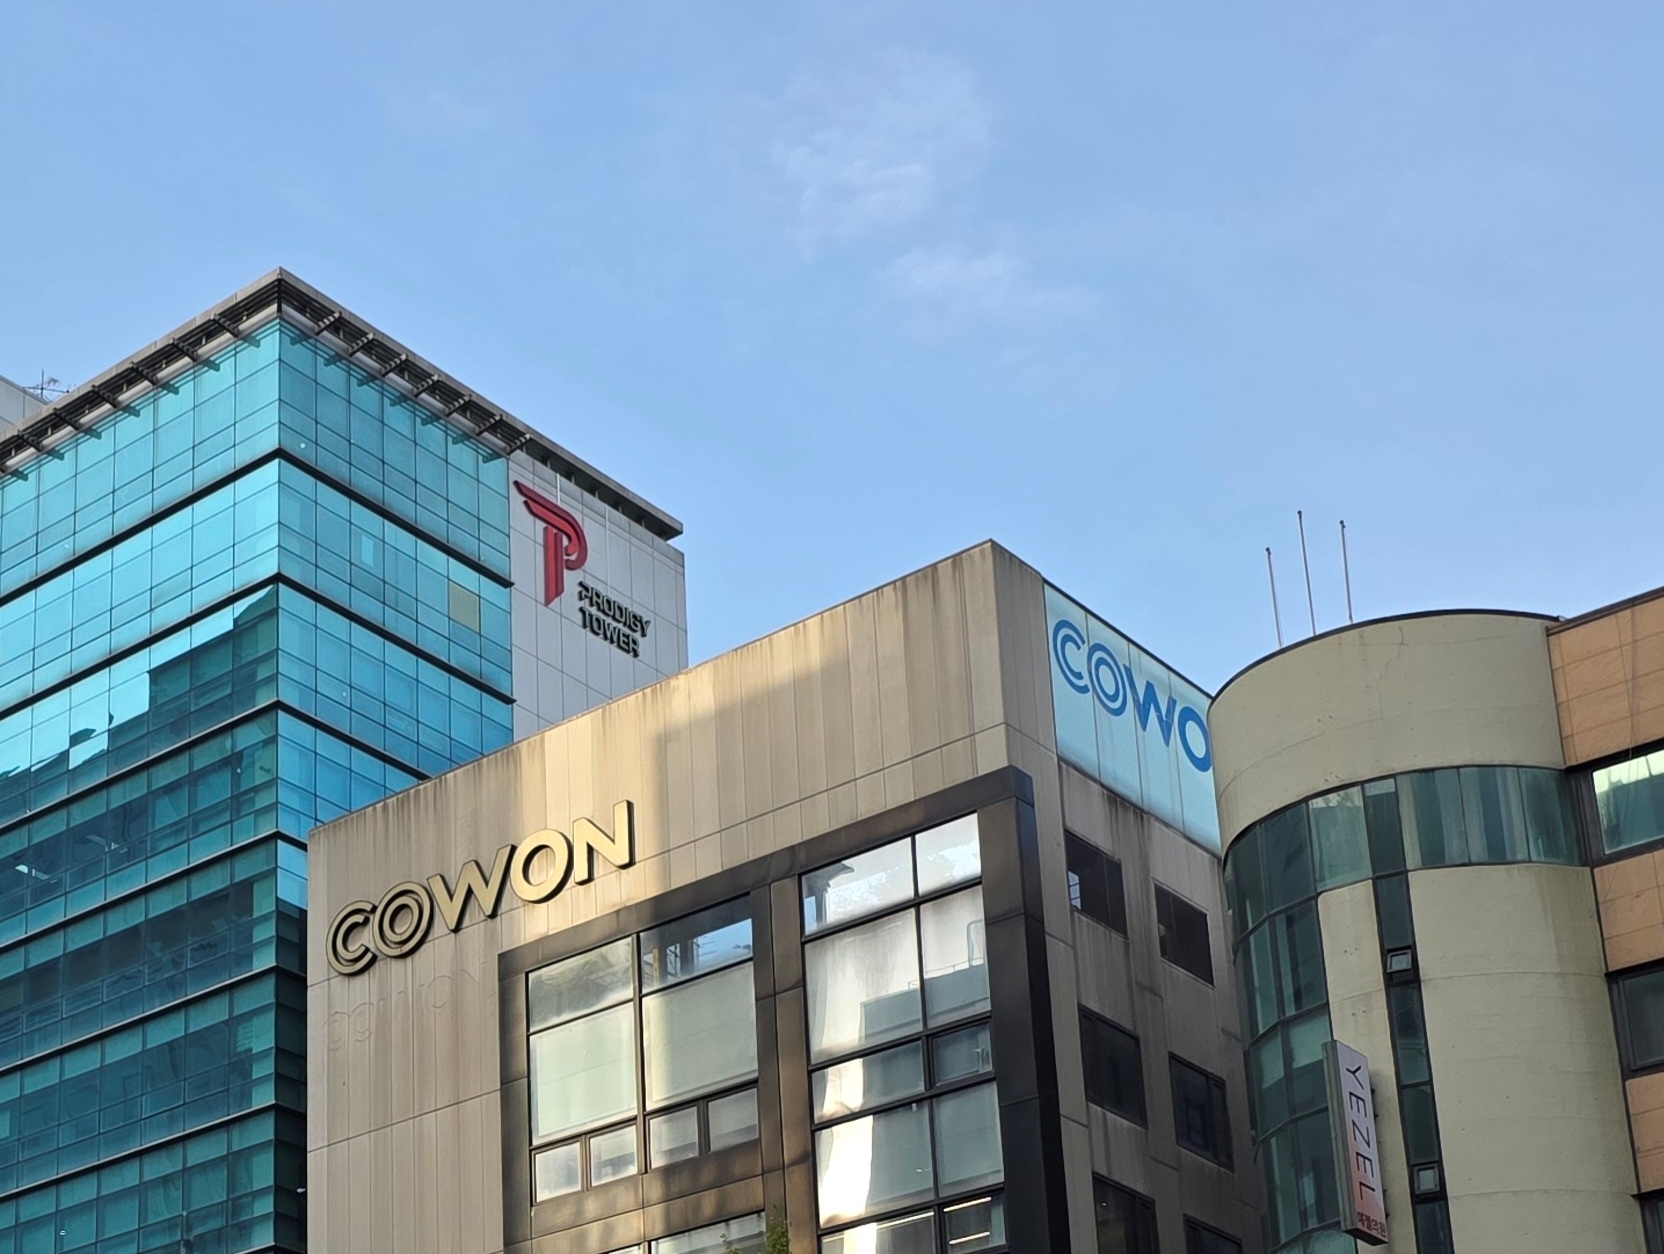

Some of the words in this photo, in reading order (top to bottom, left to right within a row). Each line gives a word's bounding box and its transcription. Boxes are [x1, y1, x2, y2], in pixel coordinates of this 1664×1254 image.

[577, 580, 651, 638] PRODIGY
[578, 606, 640, 658] TOWER
[1052, 619, 1212, 772] COWO
[325, 800, 635, 976] COWON
[1345, 1065, 1376, 1200] YEZEL
